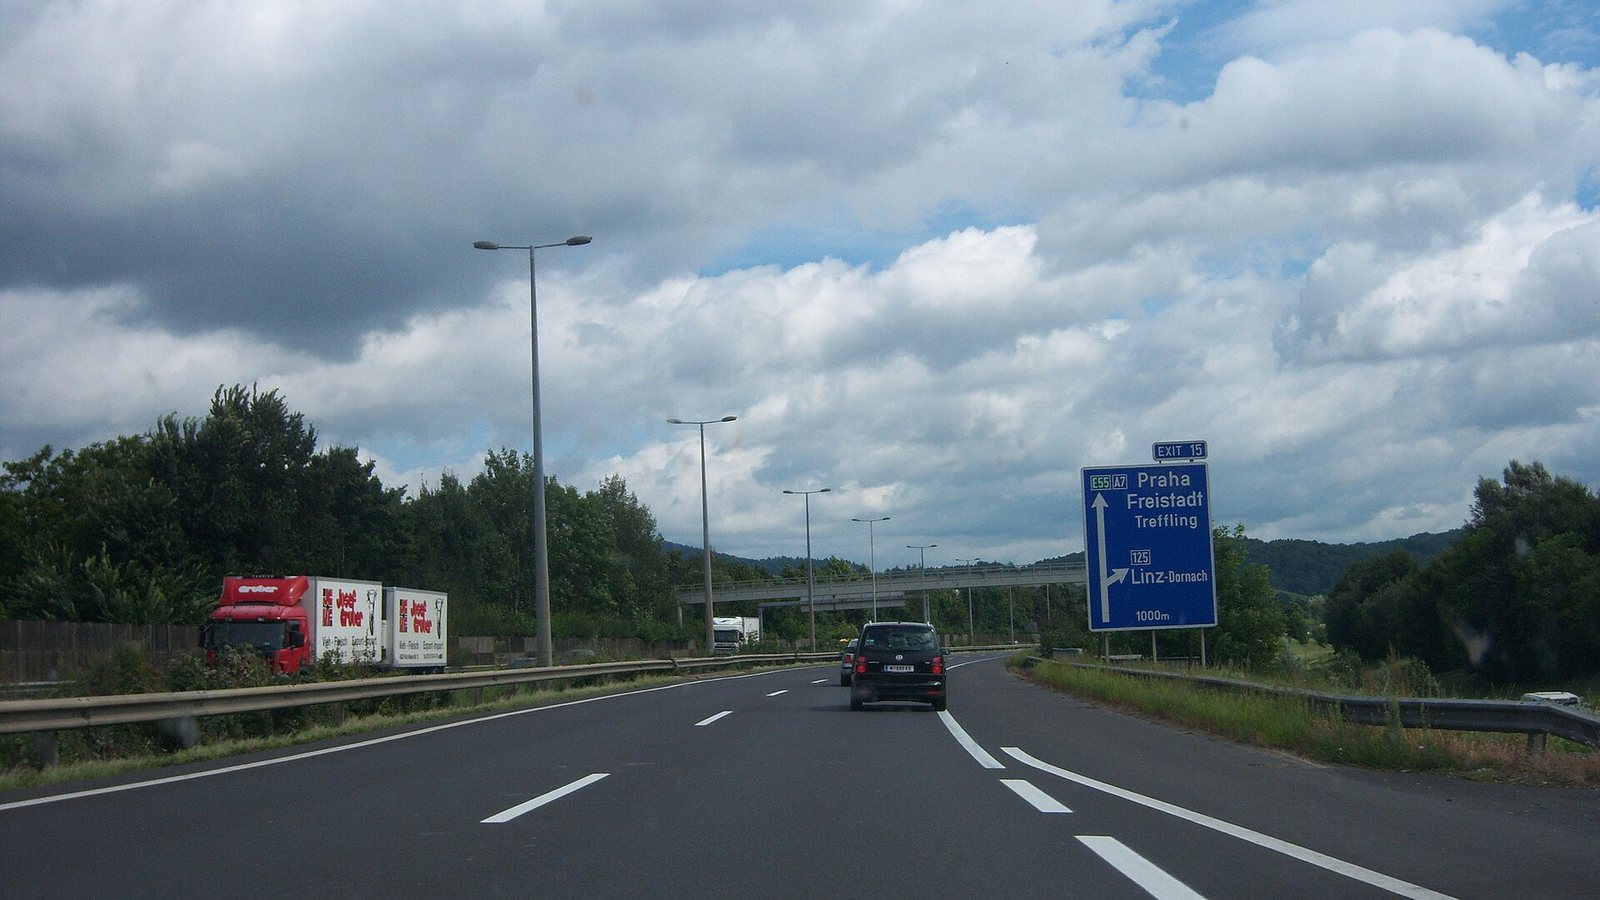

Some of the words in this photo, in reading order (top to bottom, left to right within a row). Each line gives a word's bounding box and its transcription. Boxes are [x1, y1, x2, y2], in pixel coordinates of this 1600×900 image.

[1158, 445, 1182, 457] EXIT
[1190, 443, 1203, 456] 15
[1092, 476, 1110, 489] E55
[1113, 475, 1126, 488] A7
[1138, 471, 1191, 488] Praha
[1127, 490, 1203, 510] Freistadt
[1135, 513, 1198, 529] Treffling
[1132, 551, 1149, 564] 125
[1131, 568, 1208, 585] Linz-Dornach
[1136, 610, 1170, 621] 1000m
